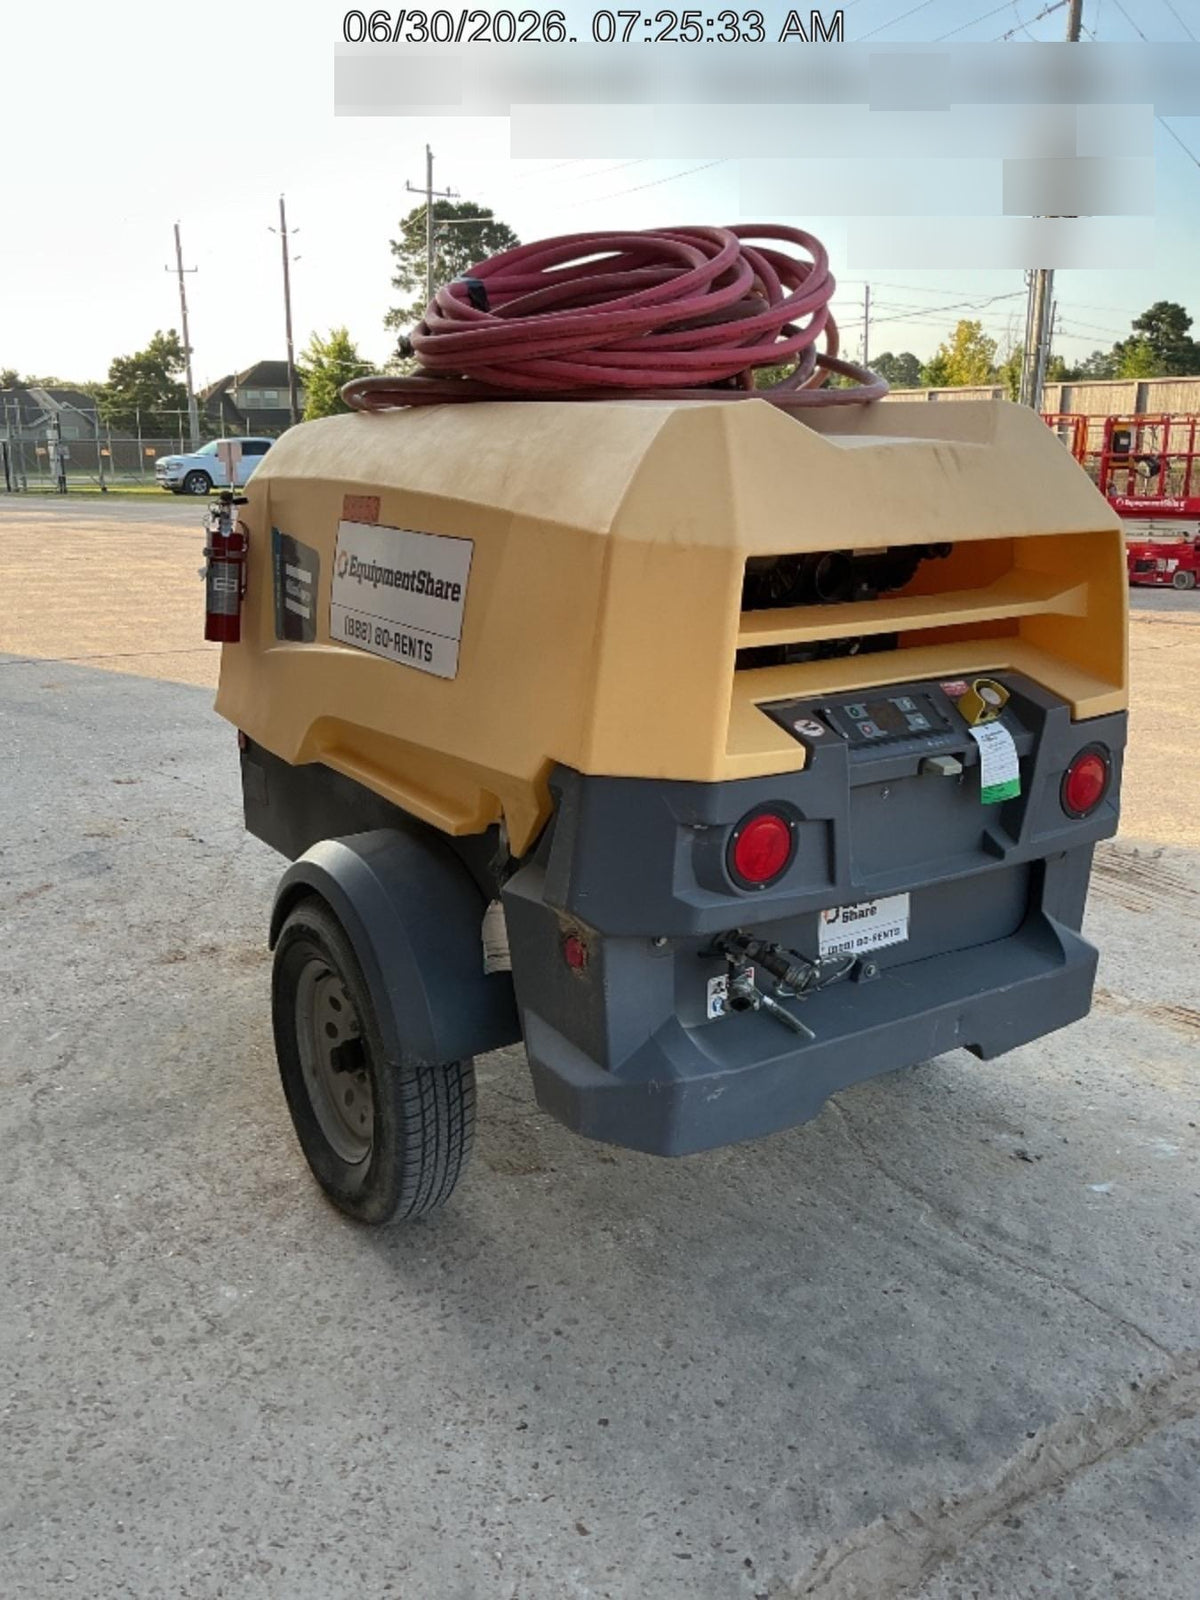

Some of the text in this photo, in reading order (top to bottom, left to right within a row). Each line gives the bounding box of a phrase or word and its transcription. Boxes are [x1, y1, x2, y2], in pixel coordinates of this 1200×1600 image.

[348, 554, 462, 602] EquipmentShare
[344, 614, 434, 663] (888) 80-RENTS
[841, 906, 878, 924] Share
